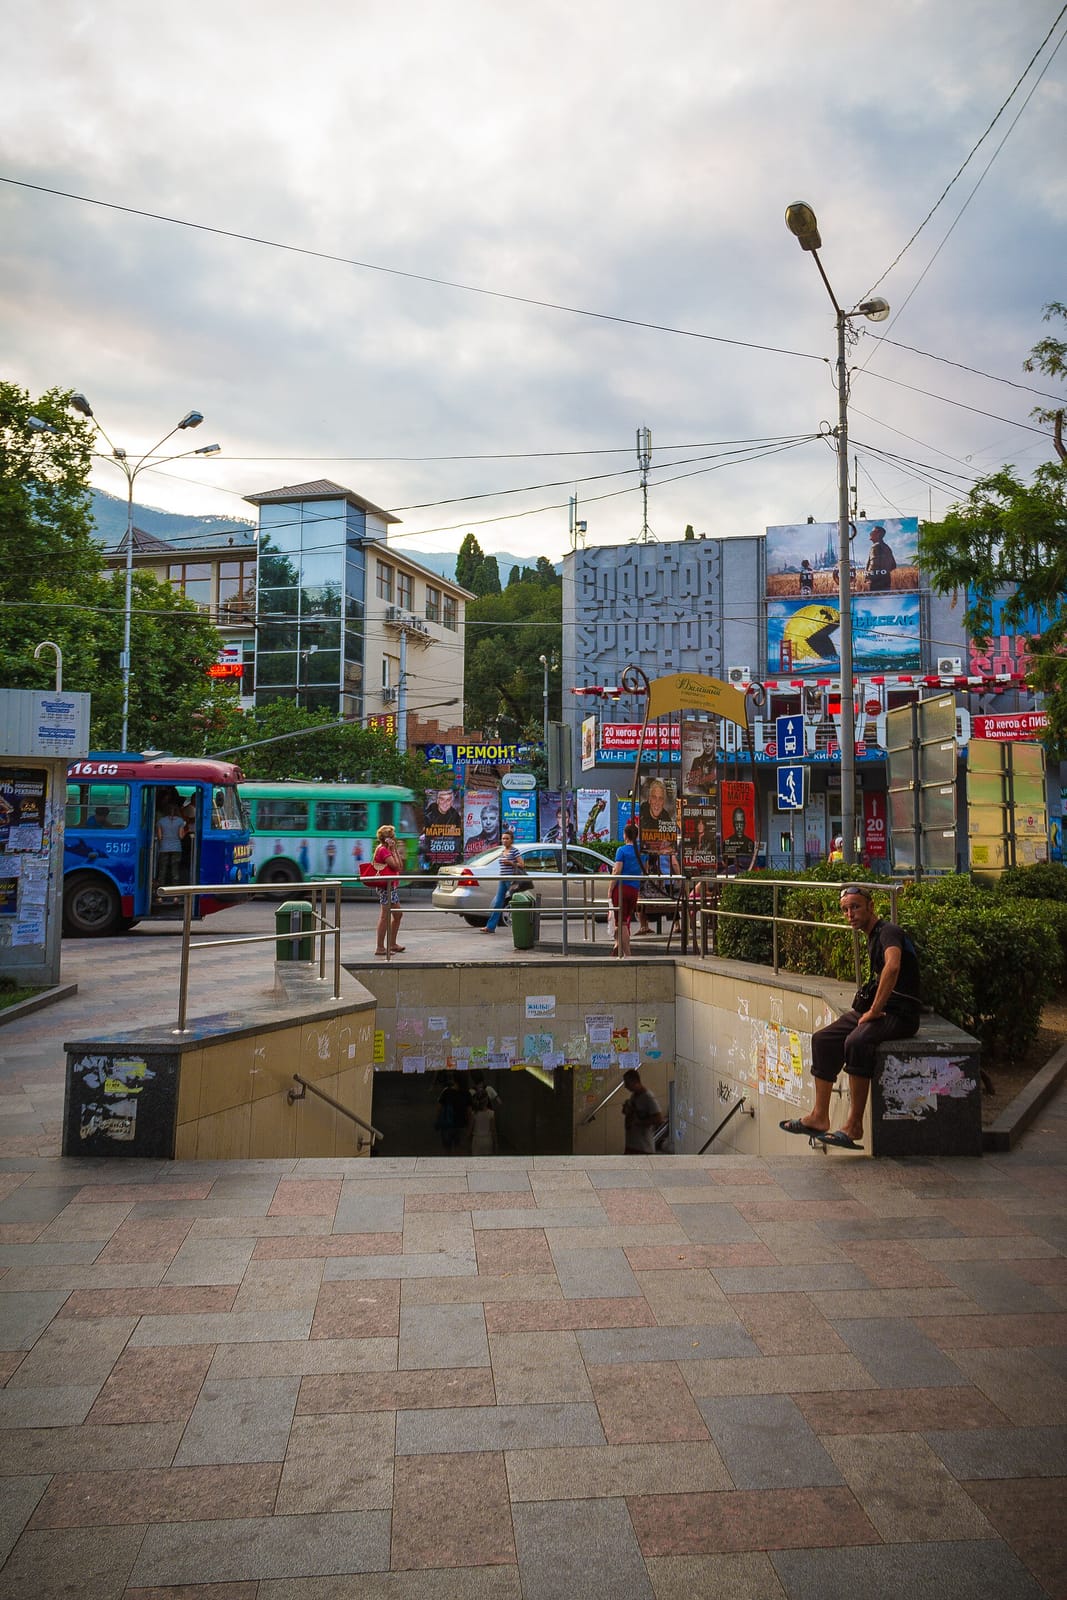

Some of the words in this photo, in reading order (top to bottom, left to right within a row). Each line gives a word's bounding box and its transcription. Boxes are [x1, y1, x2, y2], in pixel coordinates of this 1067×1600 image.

[576, 541, 721, 568] КИНО
[575, 560, 721, 601] СПАРТАК
[575, 596, 721, 622] CINEMA
[576, 614, 721, 654] SPARTAK
[985, 720, 994, 730] 20
[996, 719, 1019, 729] кегов
[605, 727, 614, 737] 20
[616, 729, 636, 739] кегов
[606, 737, 634, 745] Больше
[457, 745, 516, 759] РЕМОНТ
[600, 751, 626, 760] WI-FI
[467, 812, 473, 821] 6
[659, 825, 677, 833] 20:00
[867, 819, 884, 831] 20
[641, 832, 677, 841] МАРШАЛ
[684, 855, 715, 864] TURNER
